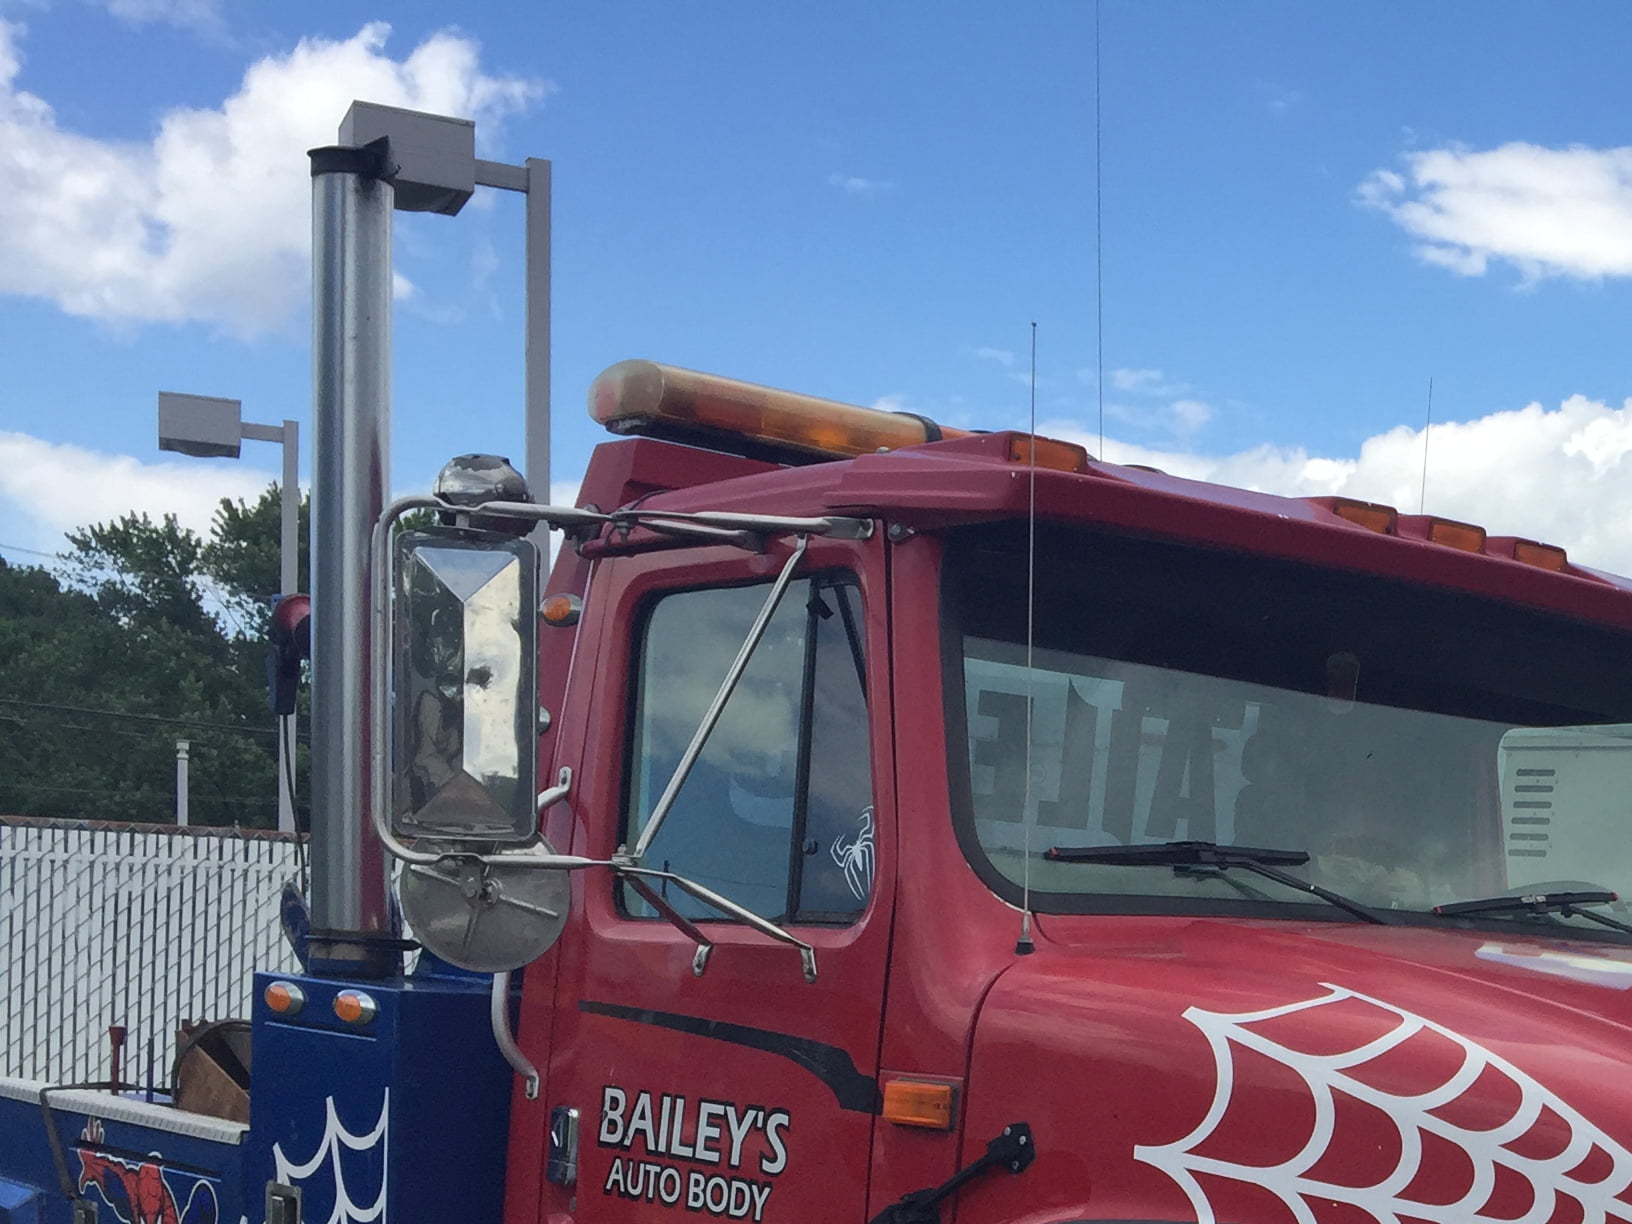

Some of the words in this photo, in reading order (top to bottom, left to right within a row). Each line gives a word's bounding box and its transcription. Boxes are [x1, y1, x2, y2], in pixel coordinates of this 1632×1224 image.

[598, 1086, 791, 1175] BAILEY'S
[605, 1157, 681, 1203] AUTO
[687, 1172, 771, 1221] BODY
